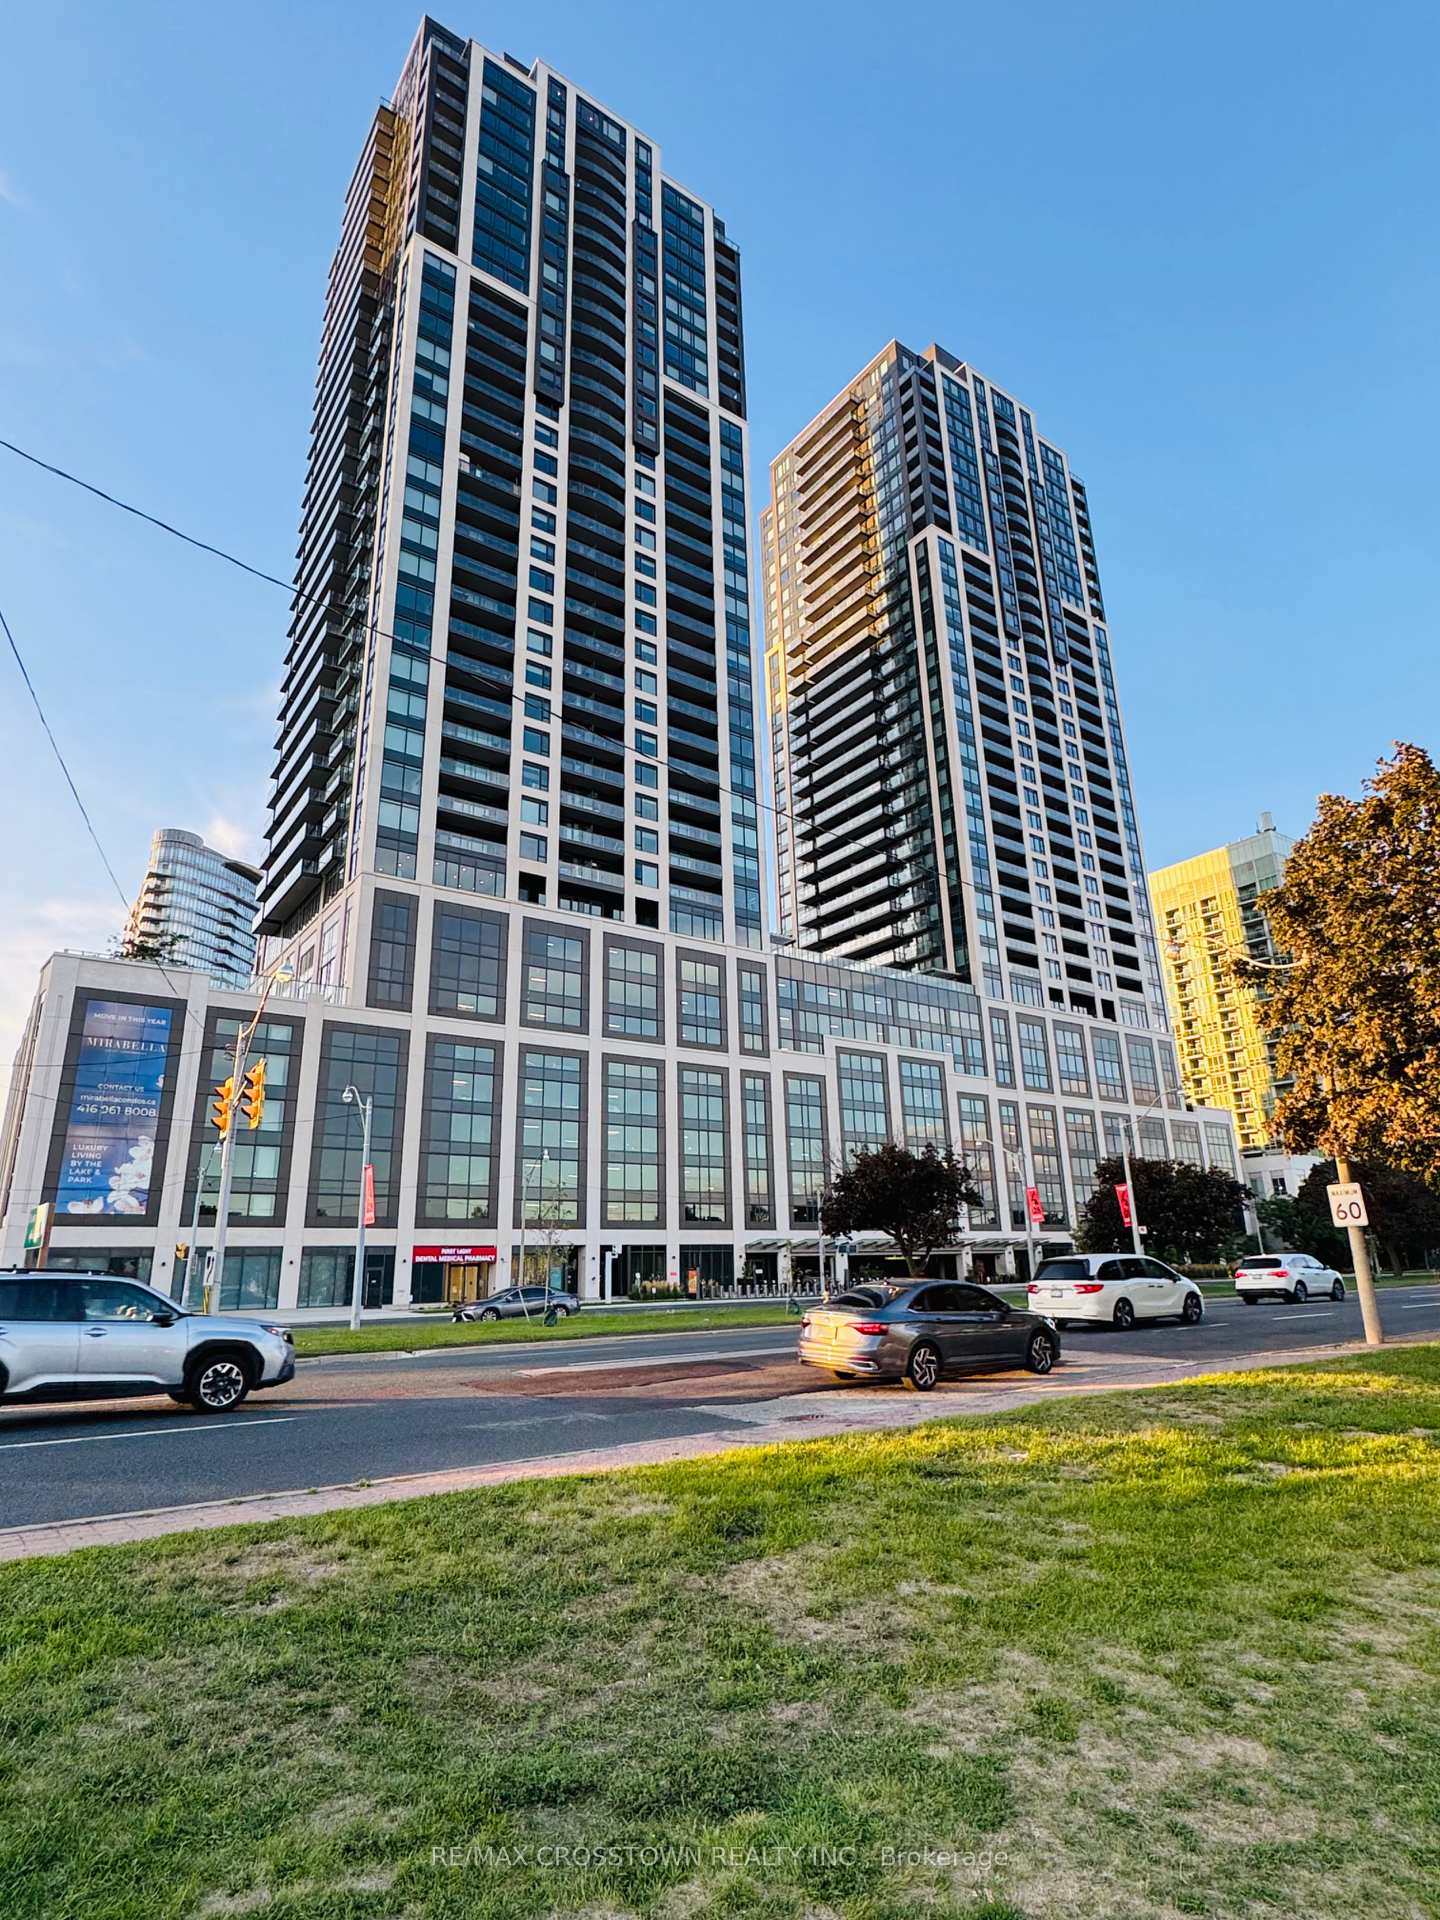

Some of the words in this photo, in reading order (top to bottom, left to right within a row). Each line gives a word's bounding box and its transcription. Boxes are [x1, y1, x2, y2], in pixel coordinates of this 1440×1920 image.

[94, 1012, 116, 1020] MOVE
[148, 1017, 167, 1025] YEAR
[87, 1037, 167, 1053] MIRABELLA
[97, 1083, 133, 1092] CONTACT
[134, 1085, 145, 1093] US
[80, 1094, 156, 1105] mirabellacondos.ca
[77, 1104, 98, 1114] 416
[124, 1106, 157, 1117] 8008
[72, 1143, 109, 1151] LUXURY
[71, 1151, 102, 1160] LIVING
[85, 1160, 102, 1168] THE
[69, 1168, 93, 1176] LAKE
[67, 1176, 93, 1184] PARK
[1336, 1201, 1361, 1220] 60
